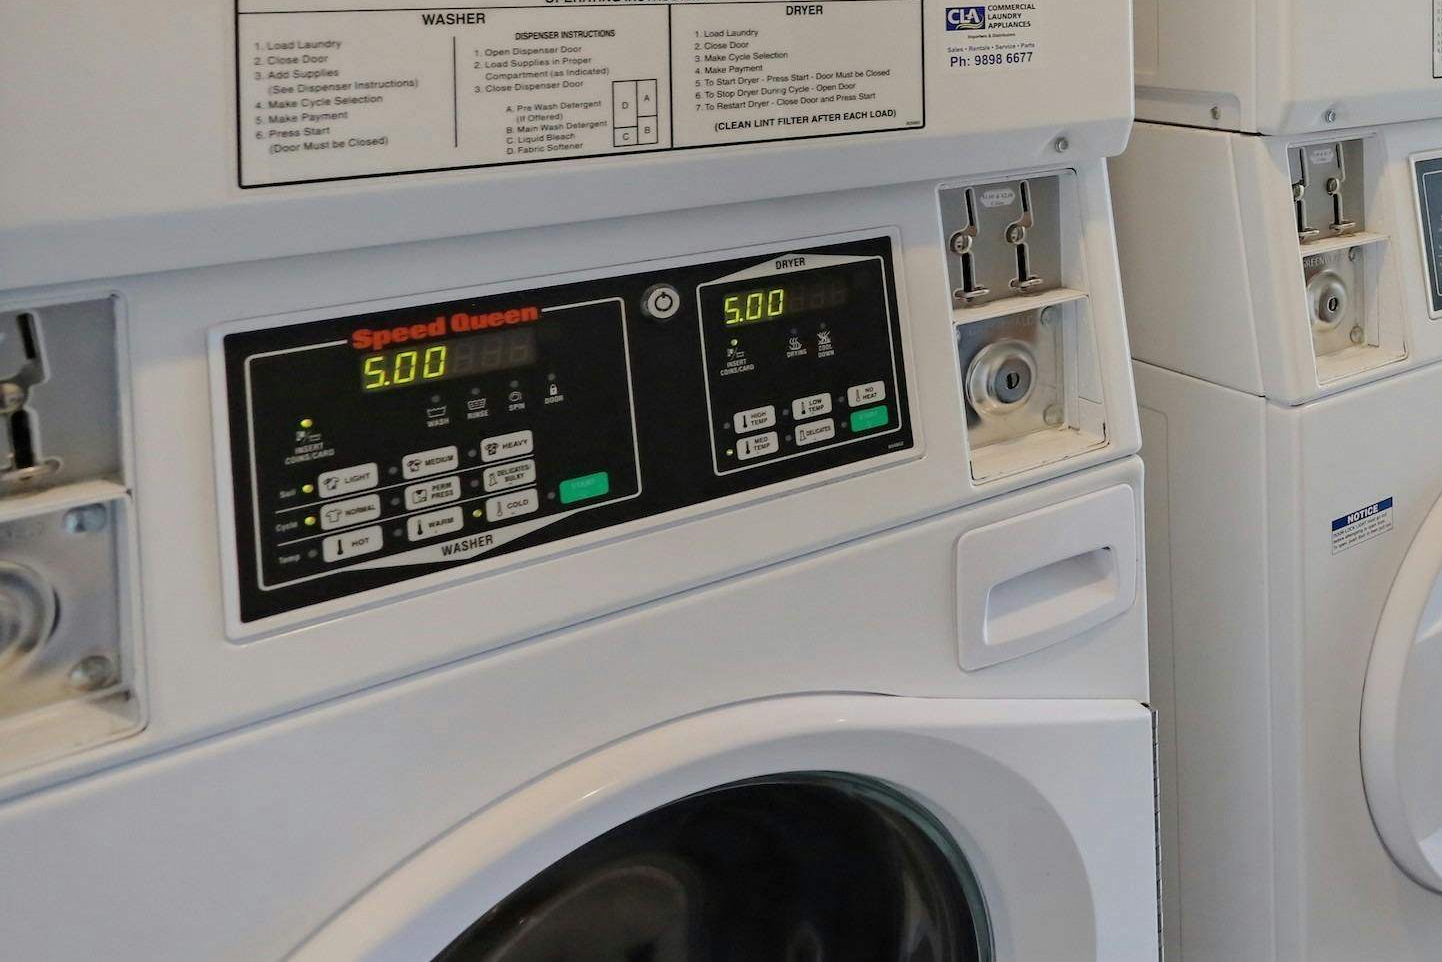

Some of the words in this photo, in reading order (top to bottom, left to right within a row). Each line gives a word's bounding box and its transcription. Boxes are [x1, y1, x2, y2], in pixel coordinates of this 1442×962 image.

[786, 5, 824, 16] DRYER
[987, 3, 1036, 12] COMMERCIAL
[422, 13, 487, 26] WASHER
[947, 8, 980, 24] CLA
[987, 12, 1022, 20] LAUNDRY
[987, 20, 1032, 29] APPLIANCES
[515, 31, 559, 40] DISPENSER
[560, 30, 616, 38] INSTRUCTIONS
[704, 30, 725, 38] Load
[726, 29, 759, 38] Laundry
[297, 40, 342, 50] Laundry
[704, 42, 727, 50] Close
[484, 48, 511, 57] Open
[512, 47, 558, 56] Dispenser
[560, 46, 582, 54] Door
[704, 54, 727, 62] Make
[728, 53, 751, 62] Cycle
[753, 52, 789, 60] Selection
[267, 56, 299, 65] Close
[302, 54, 329, 64] Door
[485, 60, 508, 68] Load
[510, 59, 551, 68] Supplies
[562, 57, 592, 65] Proper
[950, 56, 971, 67] Ph:
[974, 54, 1003, 66] 9898
[1006, 52, 1033, 64] 6677
[293, 69, 339, 80] Supplies
[485, 70, 549, 80] Compartment
[550, 70, 565, 78] (as
[566, 68, 610, 76] Indicated)
[704, 66, 727, 74] Make
[729, 65, 763, 76] Payment
[705, 78, 714, 86] To
[716, 78, 736, 86] Start
[738, 77, 760, 85] Dryer
[791, 74, 809, 82] Start
[816, 72, 834, 80] Door
[297, 83, 352, 94] Dispenser
[354, 78, 419, 90] Instructions)
[485, 84, 513, 93] Close
[514, 82, 560, 92] Dispenser
[562, 80, 584, 88] Door
[716, 90, 735, 98] Stop
[737, 89, 759, 98] Dryer
[761, 88, 787, 96] During
[788, 85, 810, 94] Cycle
[816, 84, 837, 92] Open
[268, 100, 298, 108] Make
[301, 98, 331, 108] Cycle
[334, 96, 384, 106] Selection
[643, 94, 650, 102] A
[717, 102, 746, 110] Restart
[748, 100, 769, 109] Dryer
[776, 98, 799, 106] Close
[800, 96, 818, 104] Door
[858, 92, 876, 100] Start
[517, 104, 532, 112] Pre
[560, 101, 602, 110] Detergent
[621, 102, 629, 110] D
[268, 115, 298, 124] Make
[302, 112, 348, 123] Payment
[528, 113, 563, 122] Offered)
[715, 120, 752, 132] (CLEAN
[754, 118, 776, 128] LINT
[777, 116, 809, 126] FILTER
[812, 114, 841, 122] AFTER
[843, 111, 868, 120] EACH
[870, 110, 897, 118] LOAD)
[566, 121, 608, 130] Detergent
[269, 130, 300, 138] Press
[303, 127, 331, 136] Start
[518, 136, 545, 144] Liquid
[270, 144, 301, 156] (Door
[304, 142, 330, 150] Must
[348, 137, 389, 148] Closed)
[518, 146, 545, 154] Fabric
[547, 144, 583, 152] Softener
[775, 258, 806, 270] DRYER
[724, 288, 785, 325] 5.00
[351, 317, 446, 349] Speed
[451, 306, 539, 333] Queen
[786, 348, 807, 358] DRYING
[818, 344, 833, 352] COOL
[818, 350, 835, 358] DOWN
[363, 345, 447, 390] 5.00
[726, 358, 747, 368] INSERT
[720, 364, 755, 376] COINS/CARD
[544, 395, 564, 404] DOOR
[862, 392, 878, 400] HEAT
[508, 402, 526, 412] SPIN
[809, 398, 823, 406] LOW
[808, 404, 825, 413] TEMP
[467, 410, 489, 420] RINSE
[751, 412, 767, 420] HIGH
[427, 418, 450, 428] WASH
[751, 418, 768, 426] TEMP
[806, 426, 831, 436] DELICATES
[502, 438, 528, 450] HEAVY
[754, 436, 769, 444] MED
[295, 442, 324, 454] INSERT
[753, 442, 771, 451] TEMP
[284, 448, 336, 465] COINS/CARD
[425, 454, 454, 466] MEDIUM
[344, 472, 371, 484] LIGHT
[504, 472, 525, 482] BULKY
[431, 482, 452, 492] PERM
[431, 490, 454, 500] PRESS
[506, 498, 529, 510] COLD
[345, 504, 376, 516] NORMAL
[1347, 504, 1379, 524] NOTICE
[275, 521, 299, 532] Cycle
[428, 517, 455, 528] WARM
[351, 537, 370, 548] HOT
[441, 534, 494, 556] WASHER
[278, 554, 301, 564] Temp
